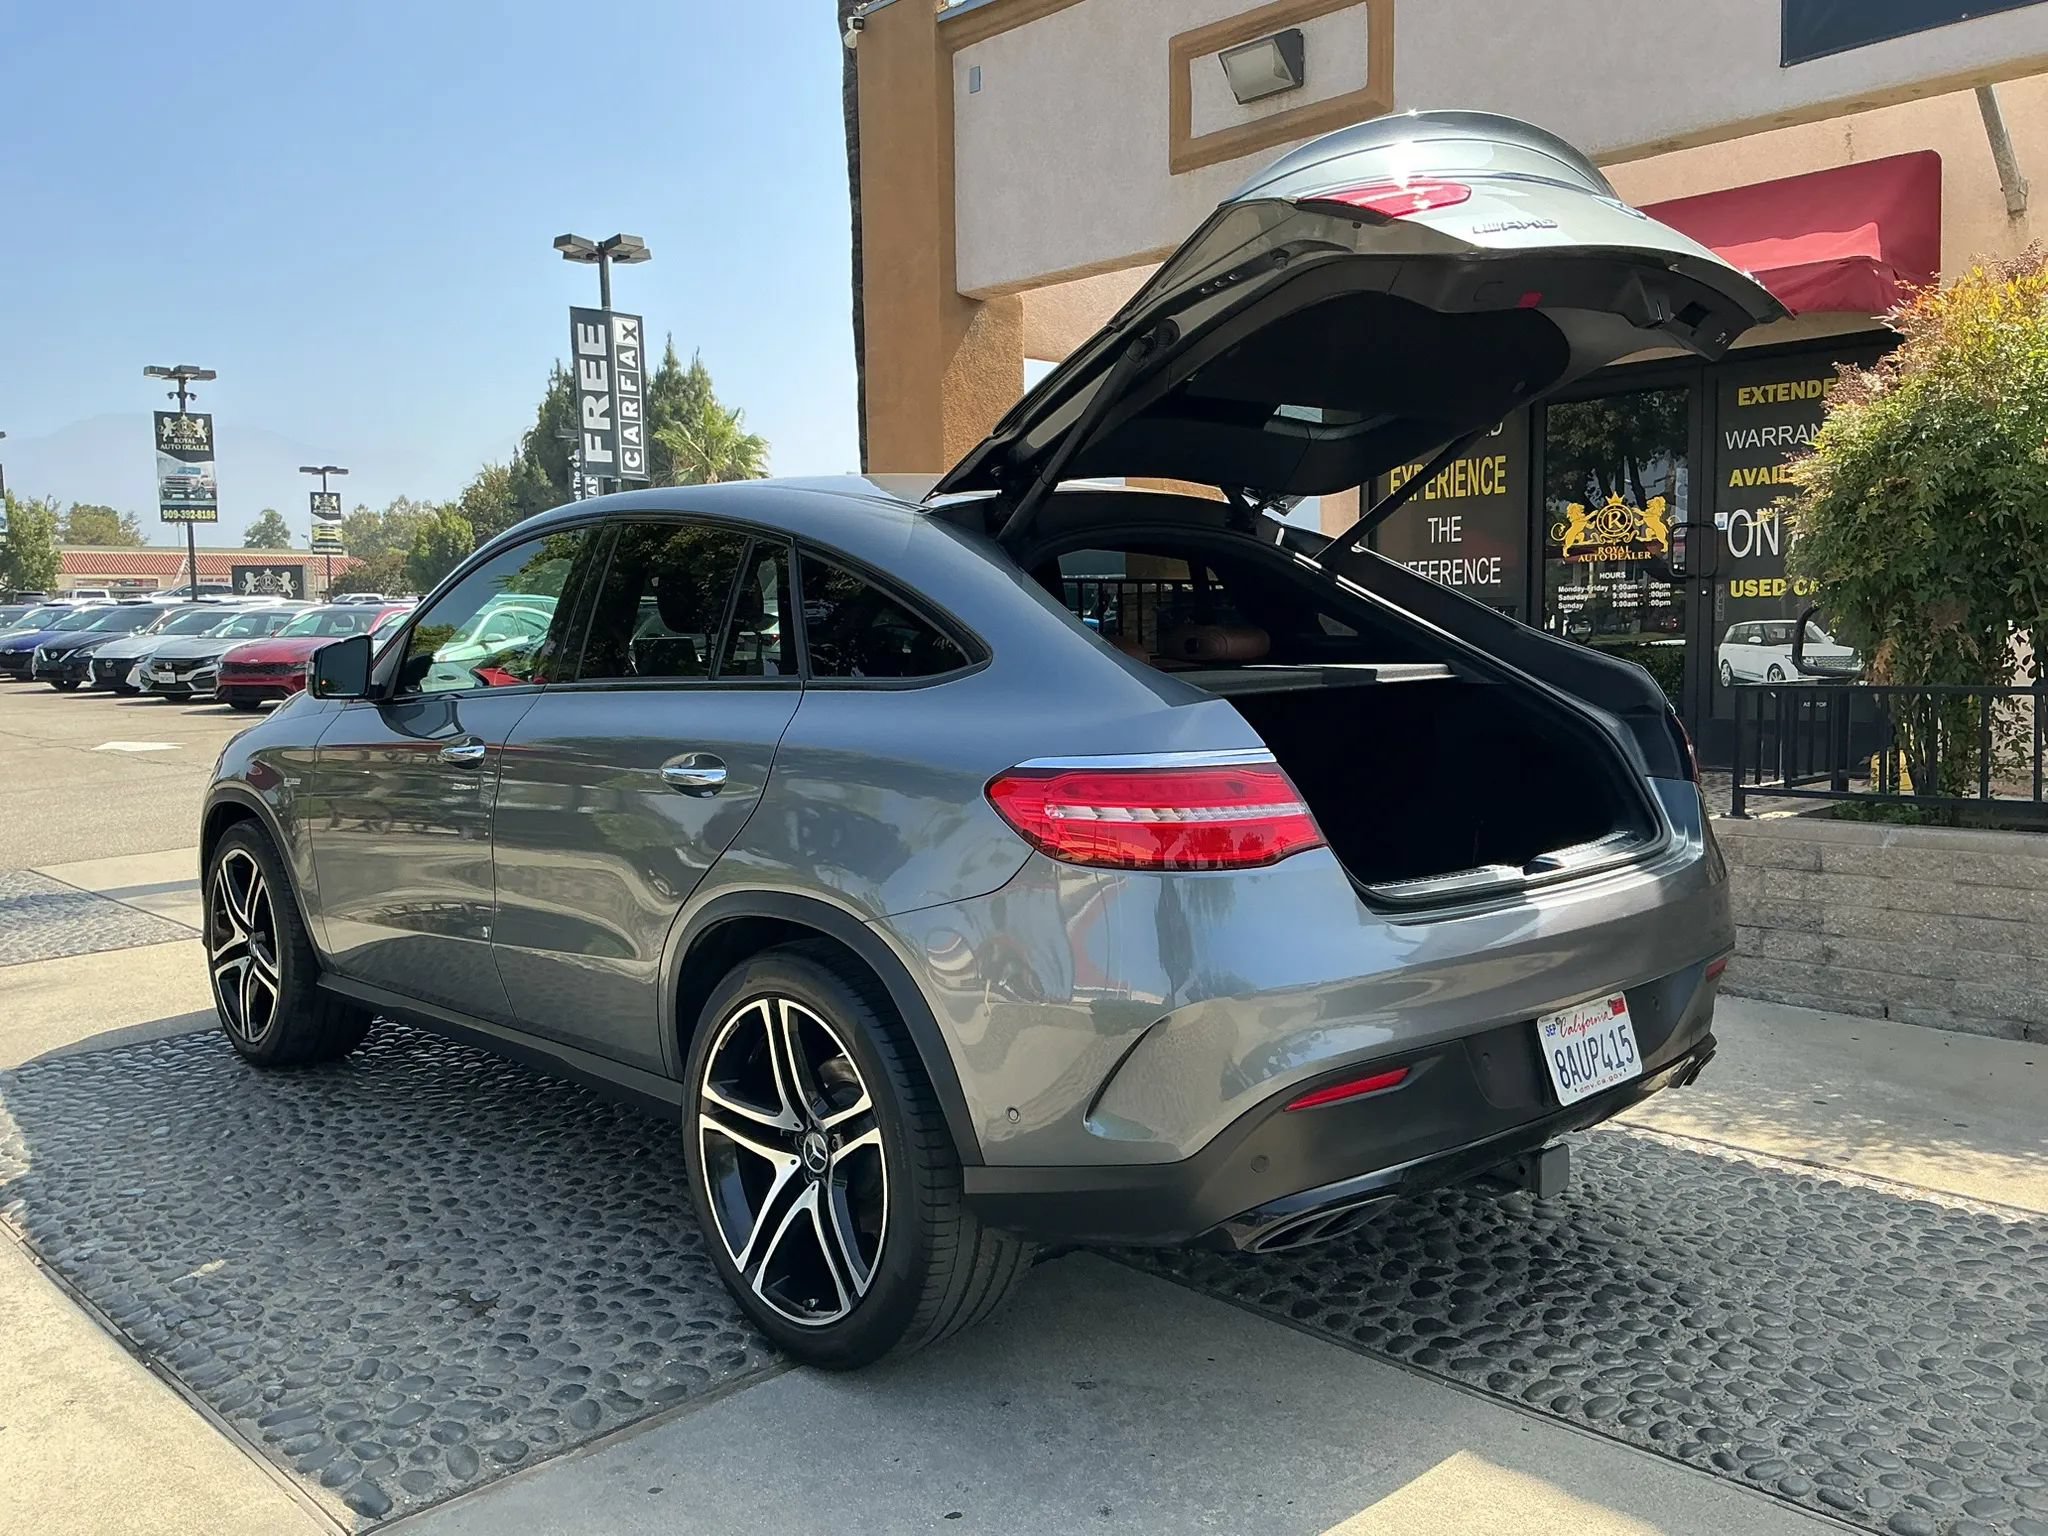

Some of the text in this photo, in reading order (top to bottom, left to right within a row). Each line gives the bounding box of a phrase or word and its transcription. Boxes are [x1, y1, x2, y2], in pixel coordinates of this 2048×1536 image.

[577, 323, 613, 463] FREE
[619, 323, 641, 468] CARFAX
[1737, 377, 1838, 407] EXTENDE
[1725, 423, 1820, 450] WARRAN
[1427, 515, 1462, 543] THE
[1727, 508, 1779, 558] ON
[1578, 551, 1652, 562] AUTO DEALER
[1598, 545, 1632, 555] ROYAL
[1599, 571, 1626, 580] HOURS
[1730, 578, 1787, 598] USED
[1558, 593, 1588, 602] Saturday
[1558, 602, 1584, 610] Sunday
[1545, 1023, 1557, 1037] SEP
[1560, 1011, 1613, 1038] California
[1554, 1024, 1635, 1090] 8AUP415
